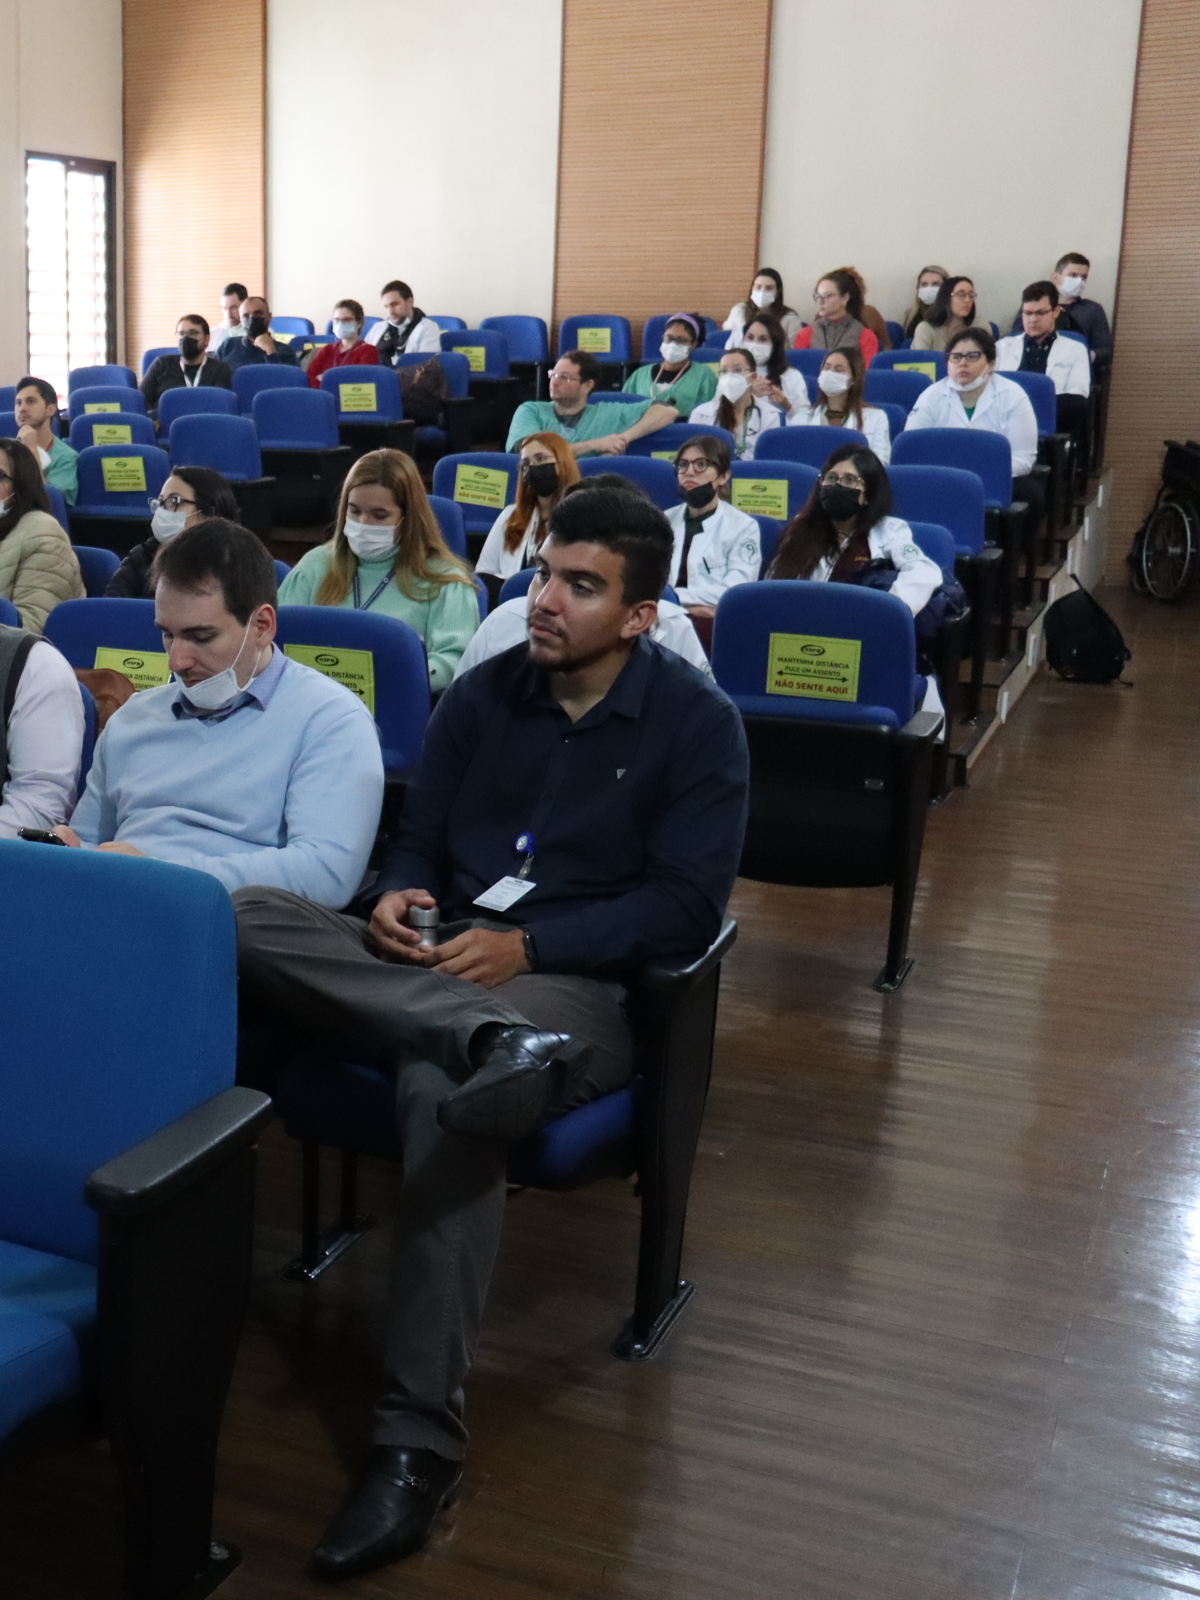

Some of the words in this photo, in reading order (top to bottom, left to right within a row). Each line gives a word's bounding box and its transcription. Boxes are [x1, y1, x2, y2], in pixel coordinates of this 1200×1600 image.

[777, 656, 814, 666] MANTENHA
[815, 659, 850, 669] DISTÂNCIA
[331, 670, 365, 680] DISTÂNCIA
[784, 665, 800, 673] PULE
[812, 668, 841, 677] ASSENTO
[133, 673, 163, 682] DISTÂNCIA
[134, 682, 155, 690] SSENTO
[775, 679, 794, 689] NÃO
[796, 682, 824, 692] SENTE
[826, 686, 848, 694] AQUI
